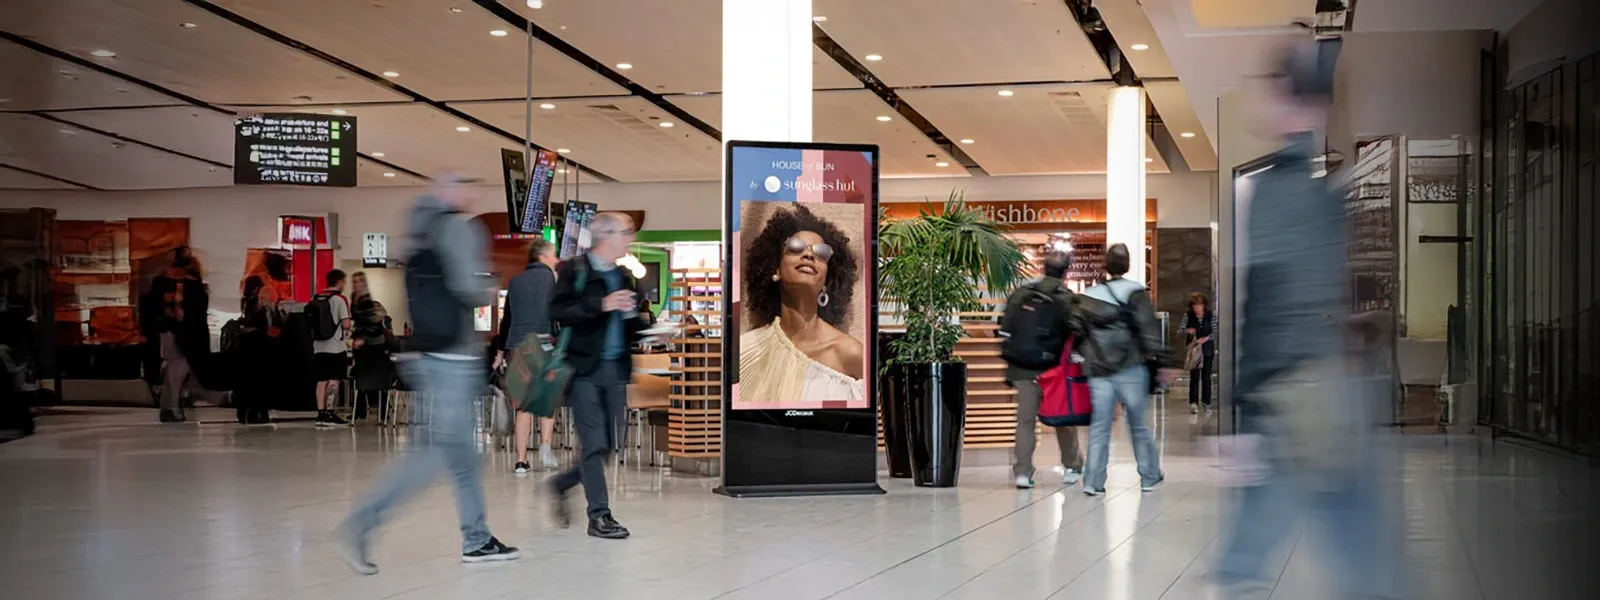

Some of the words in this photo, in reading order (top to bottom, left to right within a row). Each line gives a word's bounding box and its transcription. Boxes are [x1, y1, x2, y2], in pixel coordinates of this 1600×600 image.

[772, 161, 802, 170] HOUSE
[816, 163, 834, 171] SUN
[749, 180, 759, 190] by
[784, 180, 834, 192] sunglass
[836, 179, 855, 191] hut
